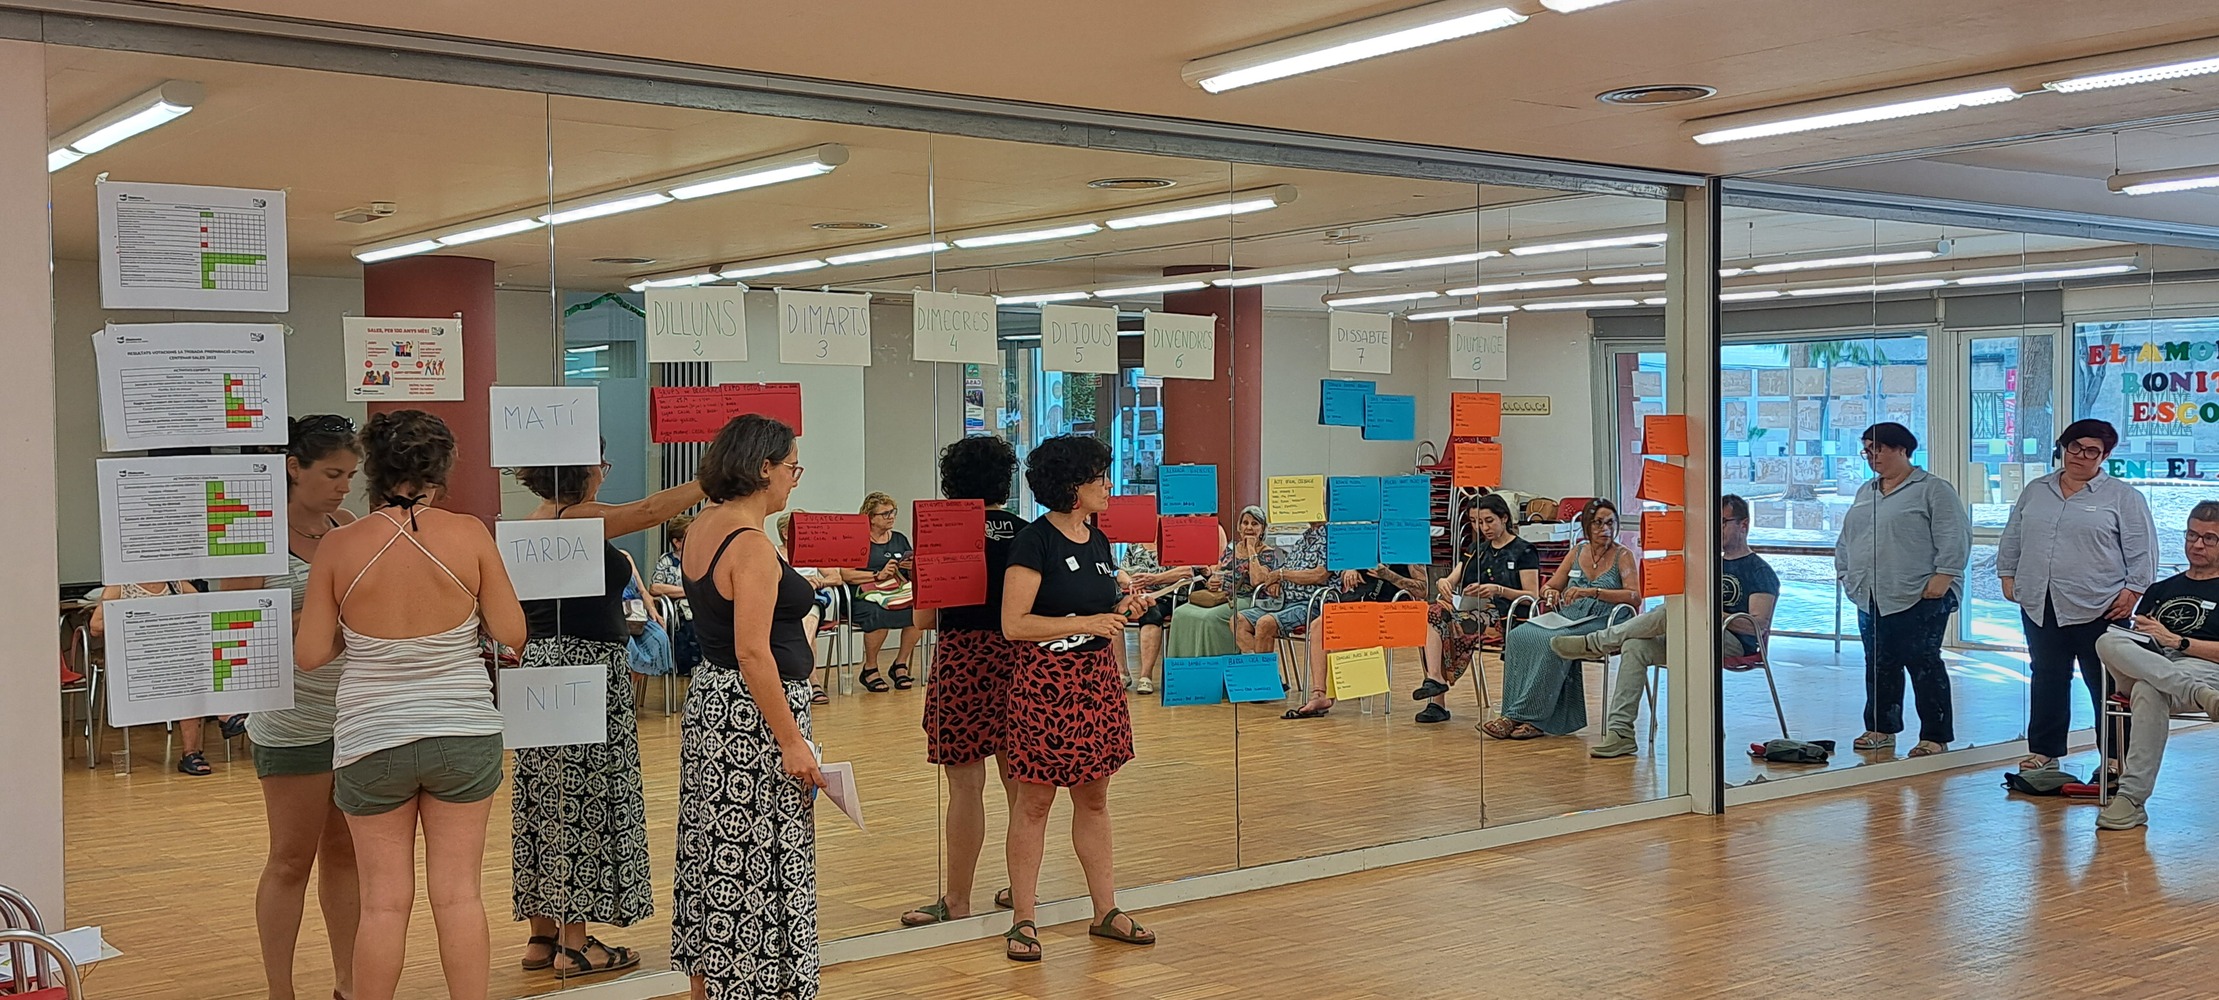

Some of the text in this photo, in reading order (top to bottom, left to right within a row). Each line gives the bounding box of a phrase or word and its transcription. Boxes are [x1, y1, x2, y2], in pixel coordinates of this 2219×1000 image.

[653, 299, 738, 338] DILLUNS
[787, 304, 869, 337] DIMARTS
[949, 334, 959, 353] 4
[1052, 321, 1113, 347] DIJOUS
[1337, 328, 1389, 345] DISSABTE
[1456, 333, 1505, 354] DIUMENGE
[692, 338, 704, 357] 2
[815, 340, 829, 358] 3
[1074, 346, 1084, 363] 5
[1356, 347, 1365, 365] 7
[2088, 341, 2219, 366] EL AMO
[1174, 353, 1184, 369] 6
[1472, 356, 1482, 371] 8
[503, 398, 580, 431] MATÍ
[2108, 457, 2205, 479] EN EL
[510, 536, 590, 563] TARDA
[525, 680, 592, 711] NIT
